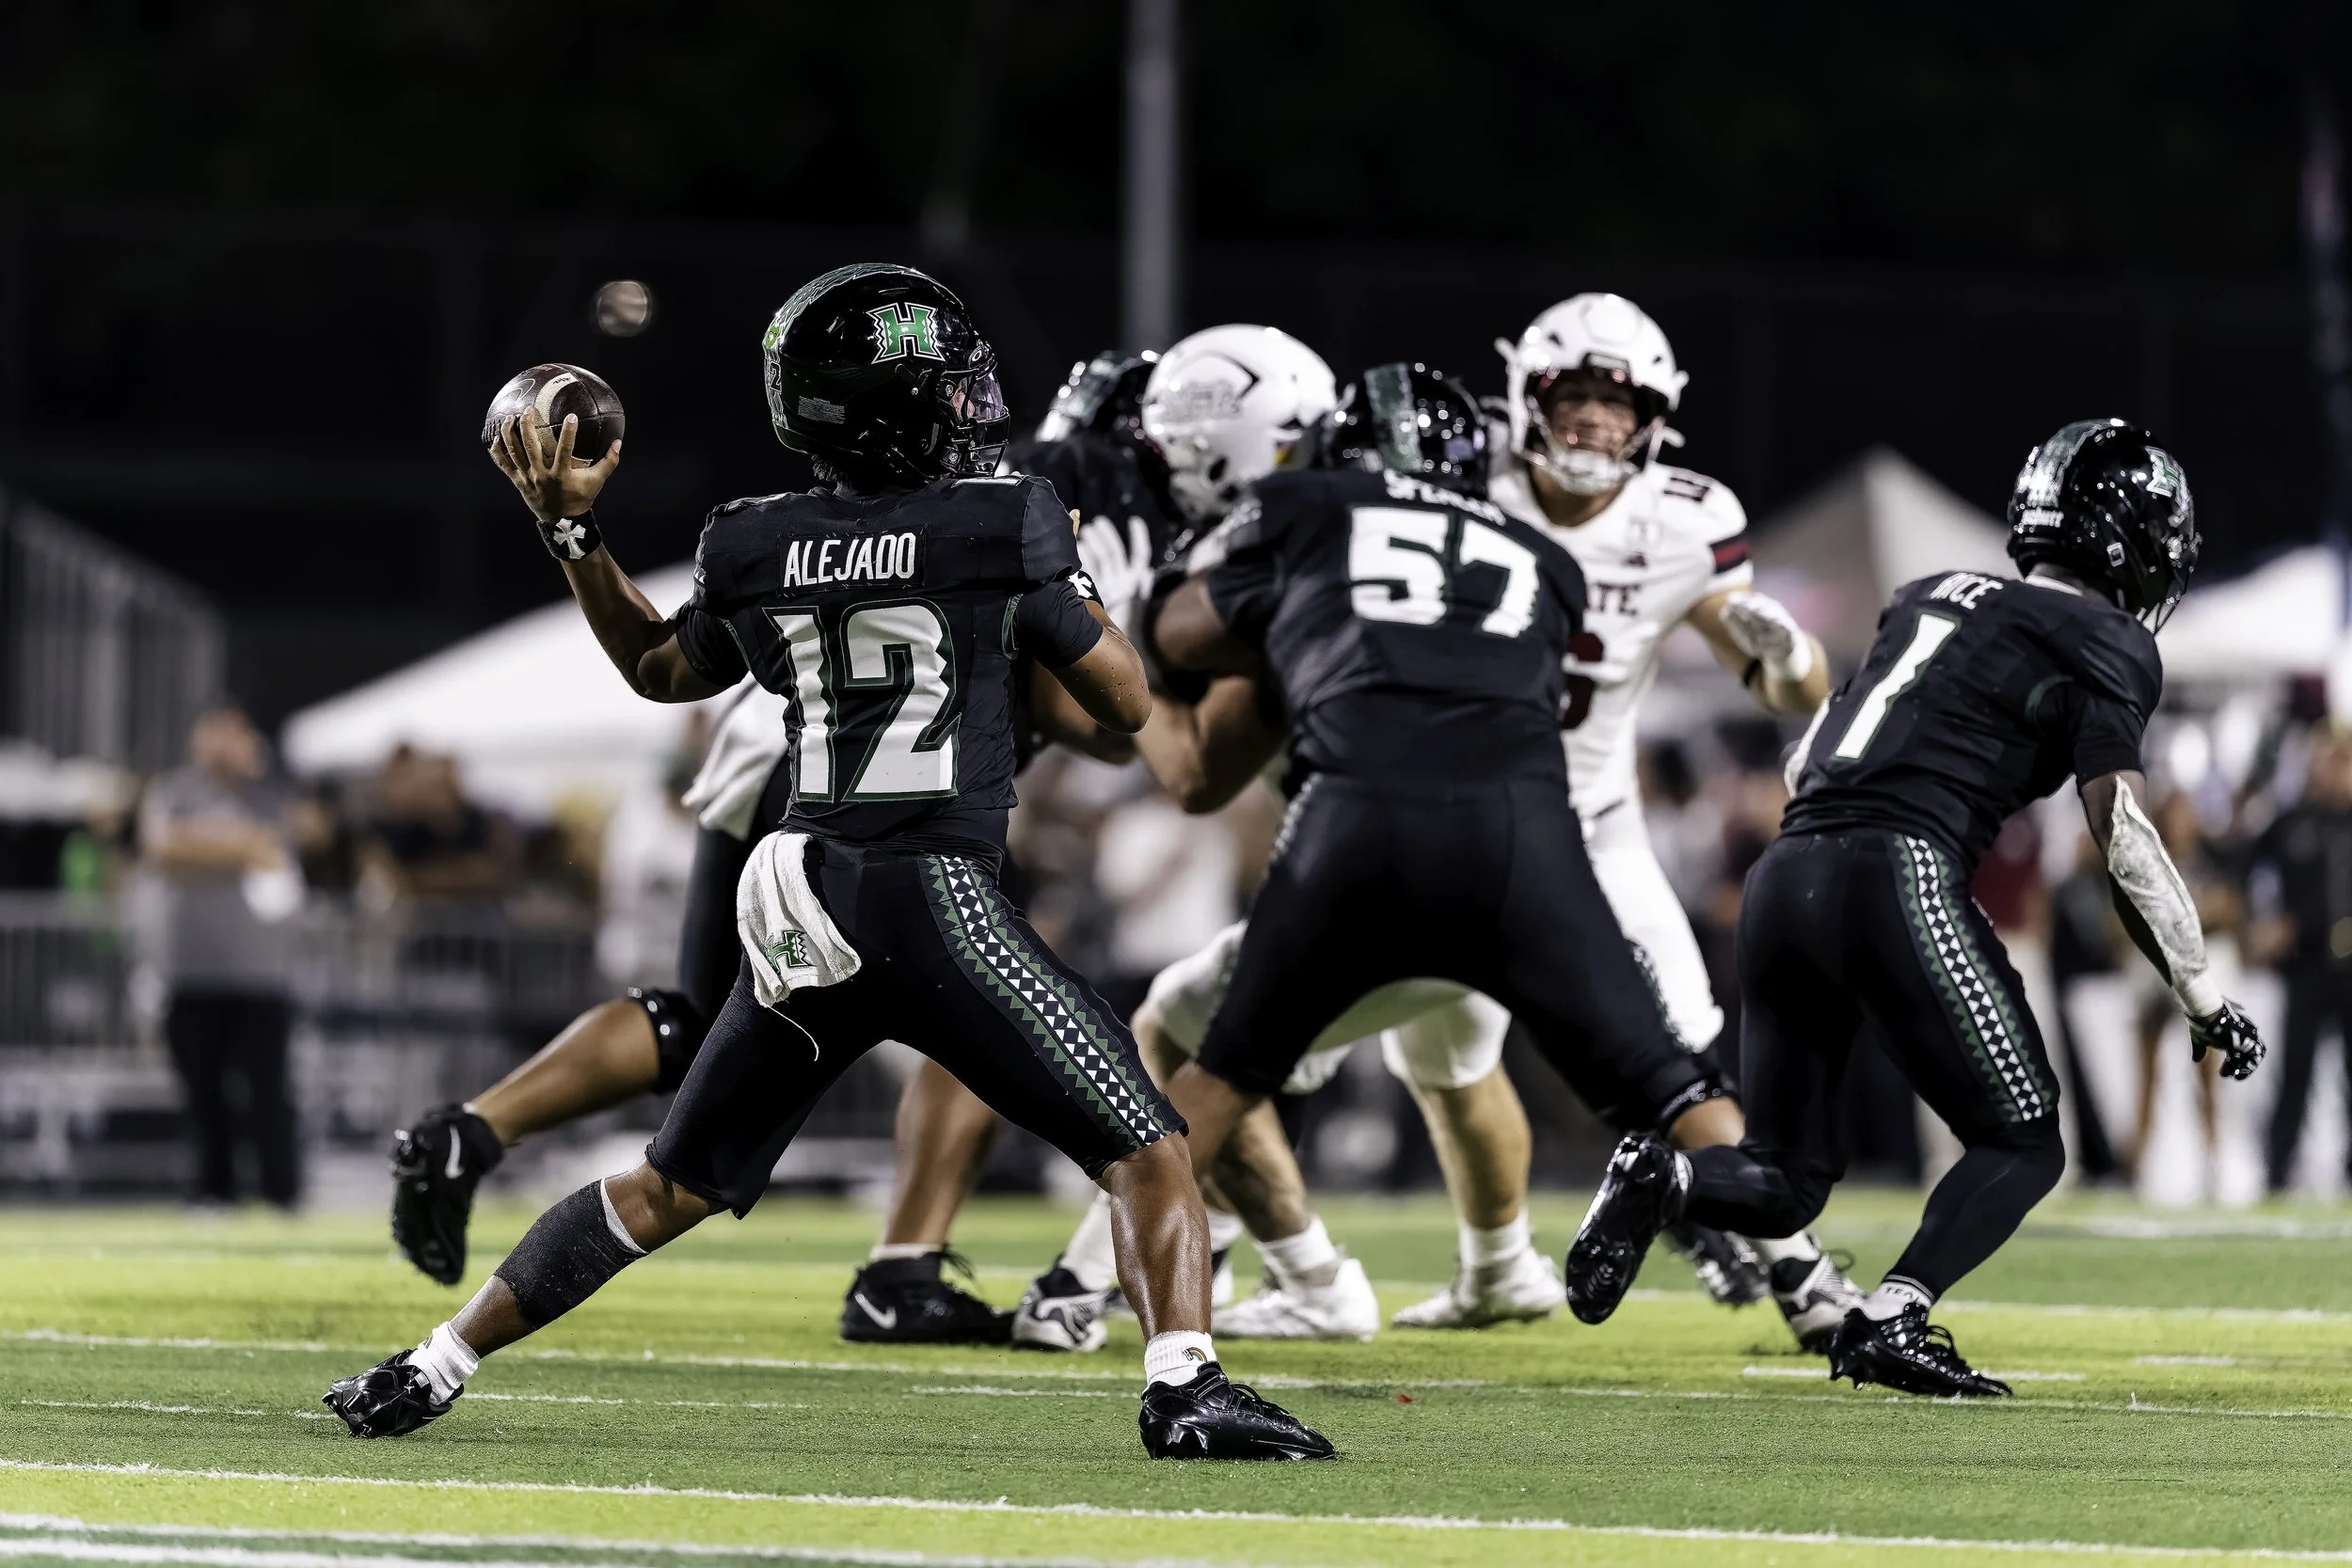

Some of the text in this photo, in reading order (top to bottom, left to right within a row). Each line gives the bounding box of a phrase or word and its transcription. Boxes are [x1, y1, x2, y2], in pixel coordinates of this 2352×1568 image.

[866, 302, 946, 365] H
[783, 531, 916, 588] ALEJADO
[1348, 505, 1540, 639] 57
[762, 597, 961, 803] 12
[1833, 610, 1959, 761] 1
